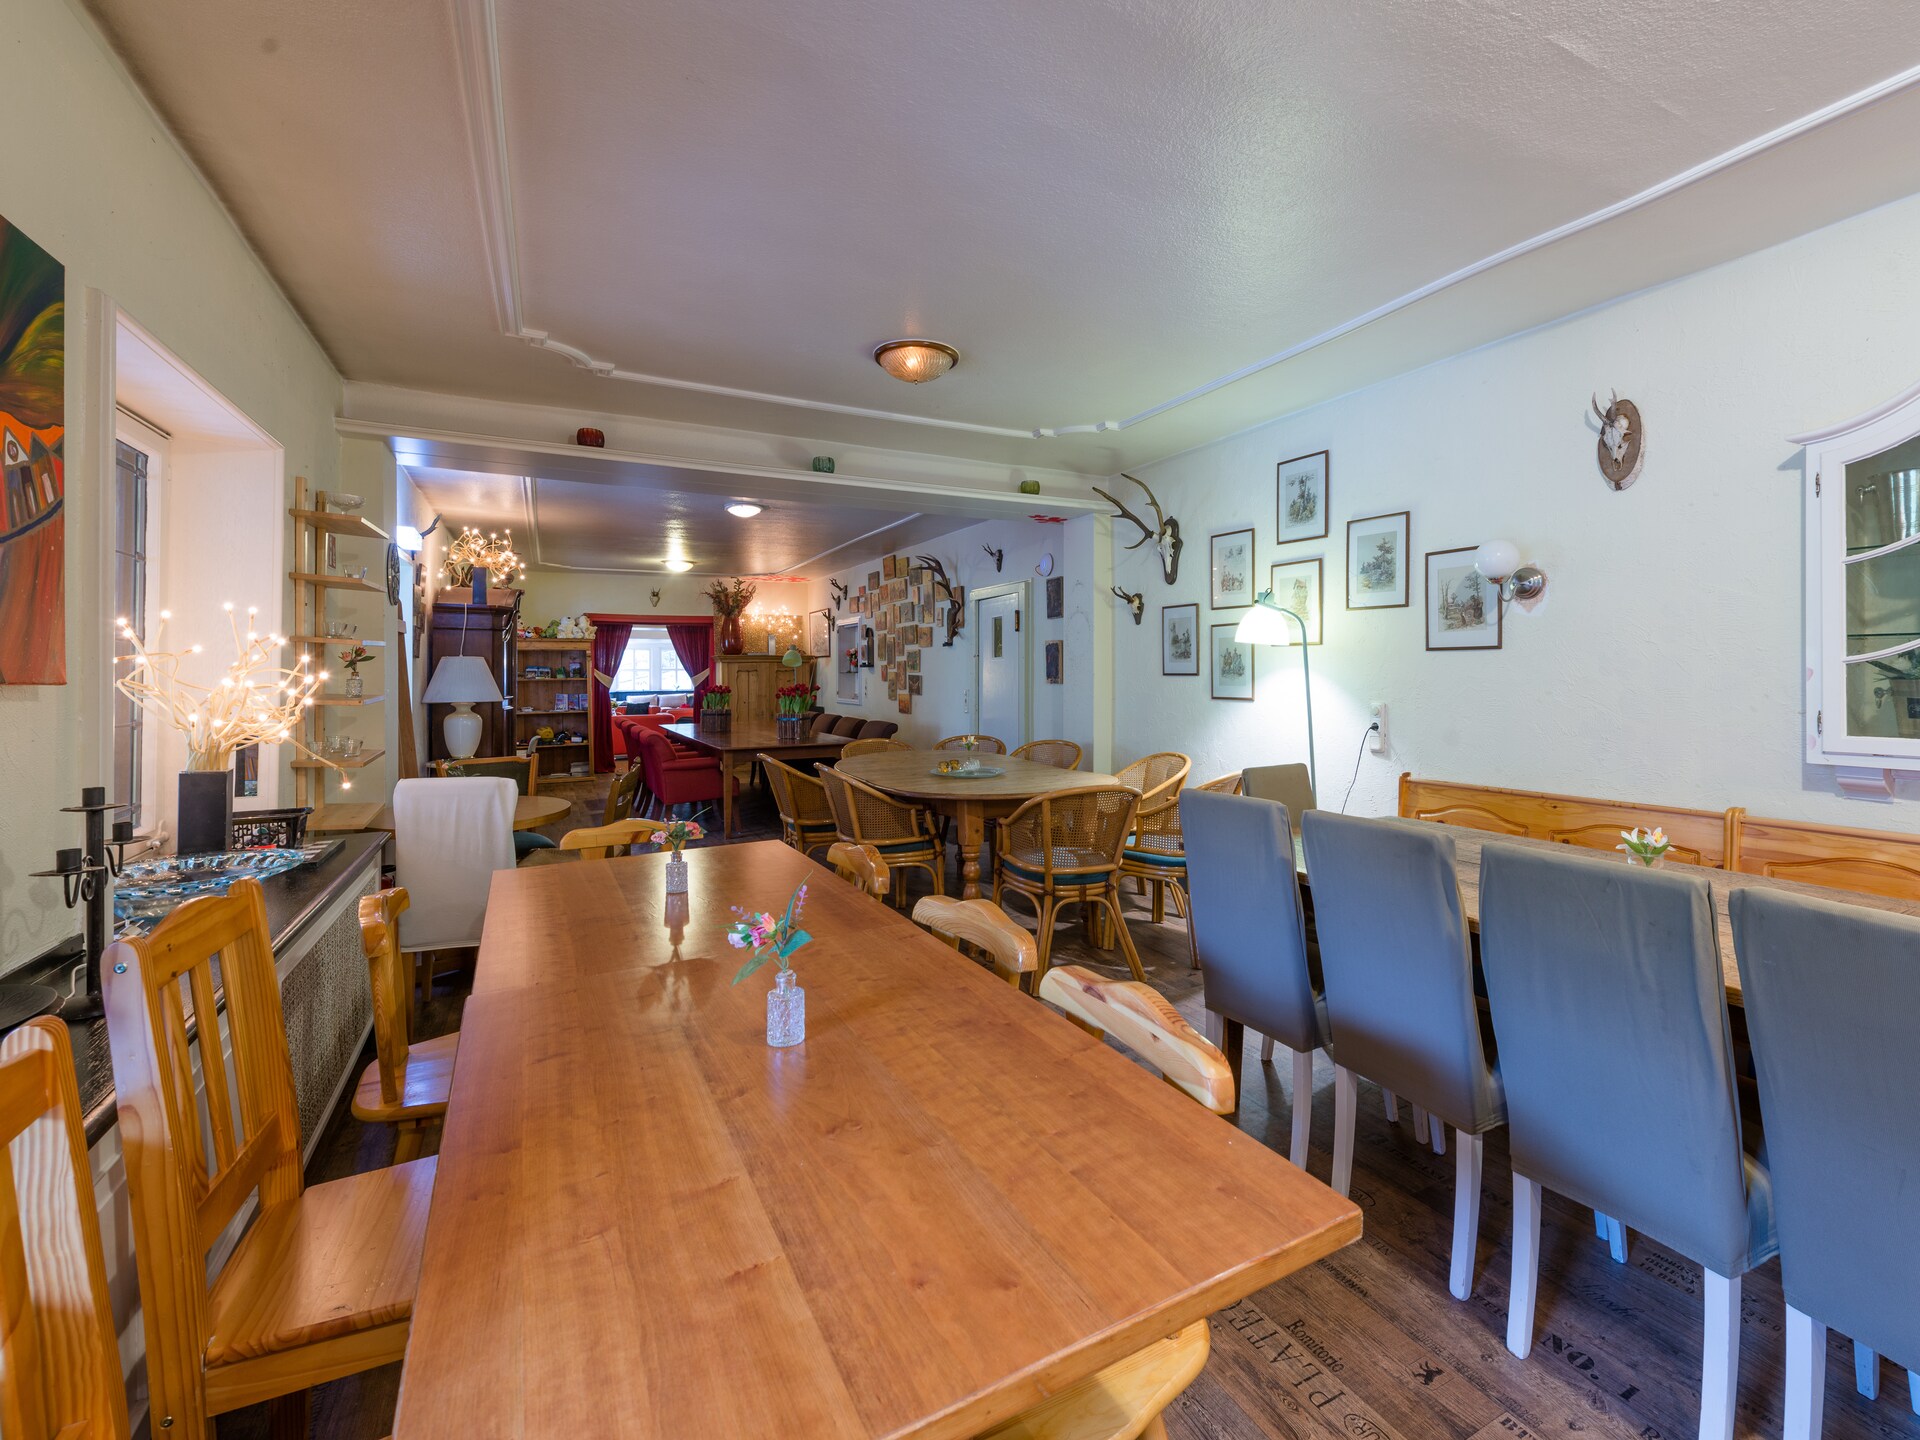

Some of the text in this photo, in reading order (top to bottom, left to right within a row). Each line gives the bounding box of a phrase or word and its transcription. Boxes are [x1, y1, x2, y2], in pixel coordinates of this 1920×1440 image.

[1285, 1318, 1346, 1375] Romitorio
[1539, 1333, 1641, 1402] NO. 1
